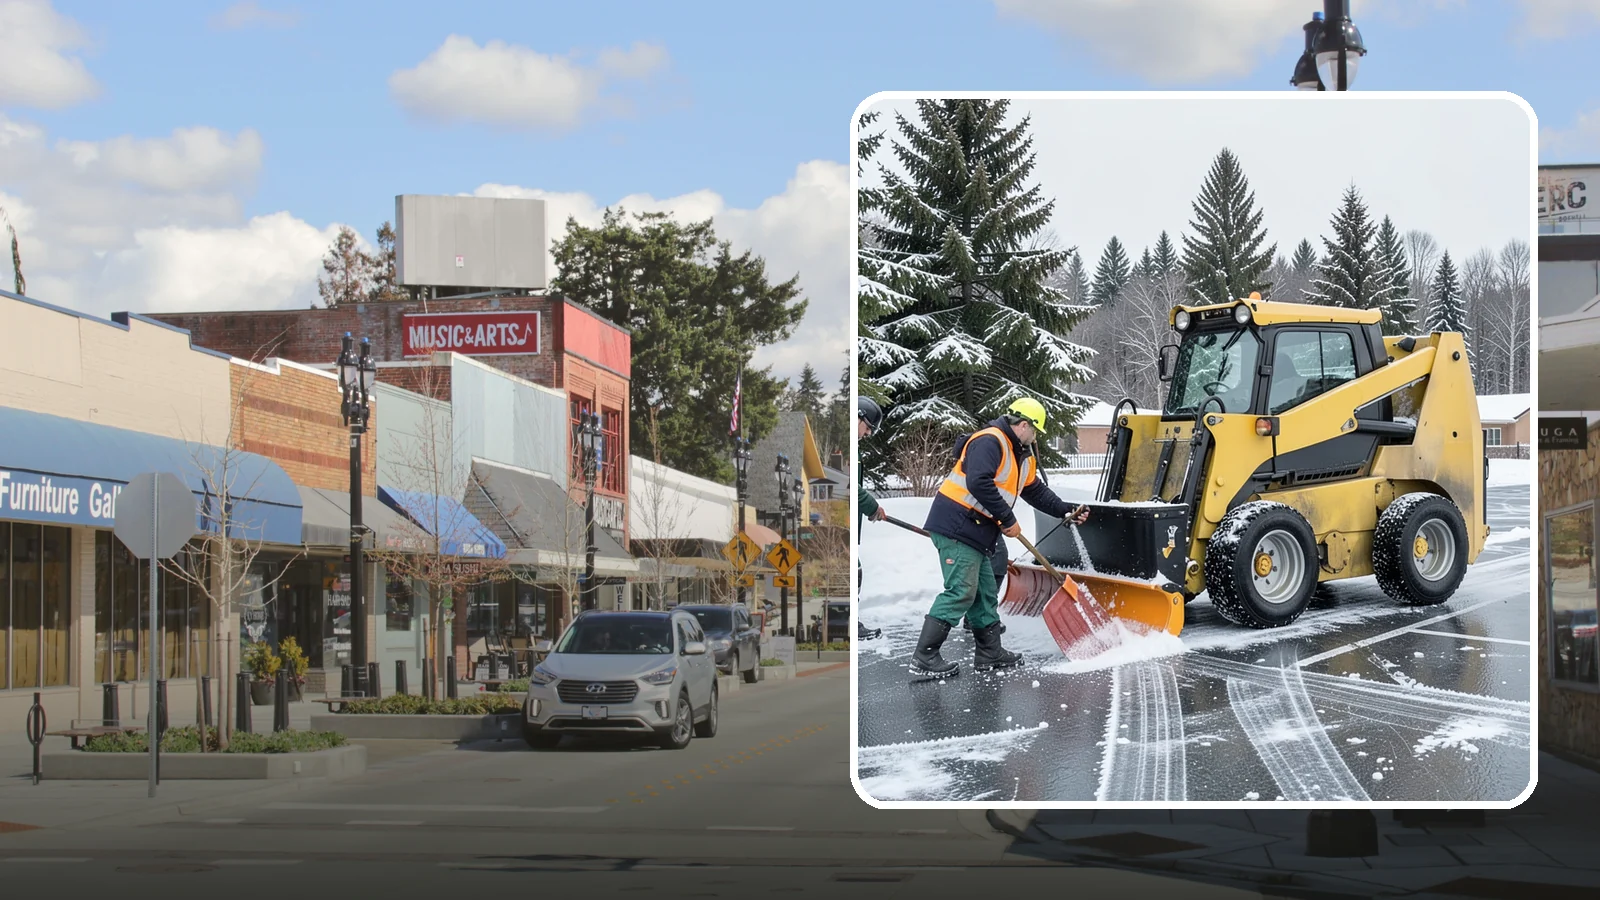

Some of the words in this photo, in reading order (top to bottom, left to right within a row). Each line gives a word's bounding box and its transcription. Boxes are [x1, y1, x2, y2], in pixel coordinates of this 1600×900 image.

[409, 322, 519, 349] MUSIC&ARTS
[0, 471, 79, 515] Furniture
[453, 562, 479, 574] SUSHI
